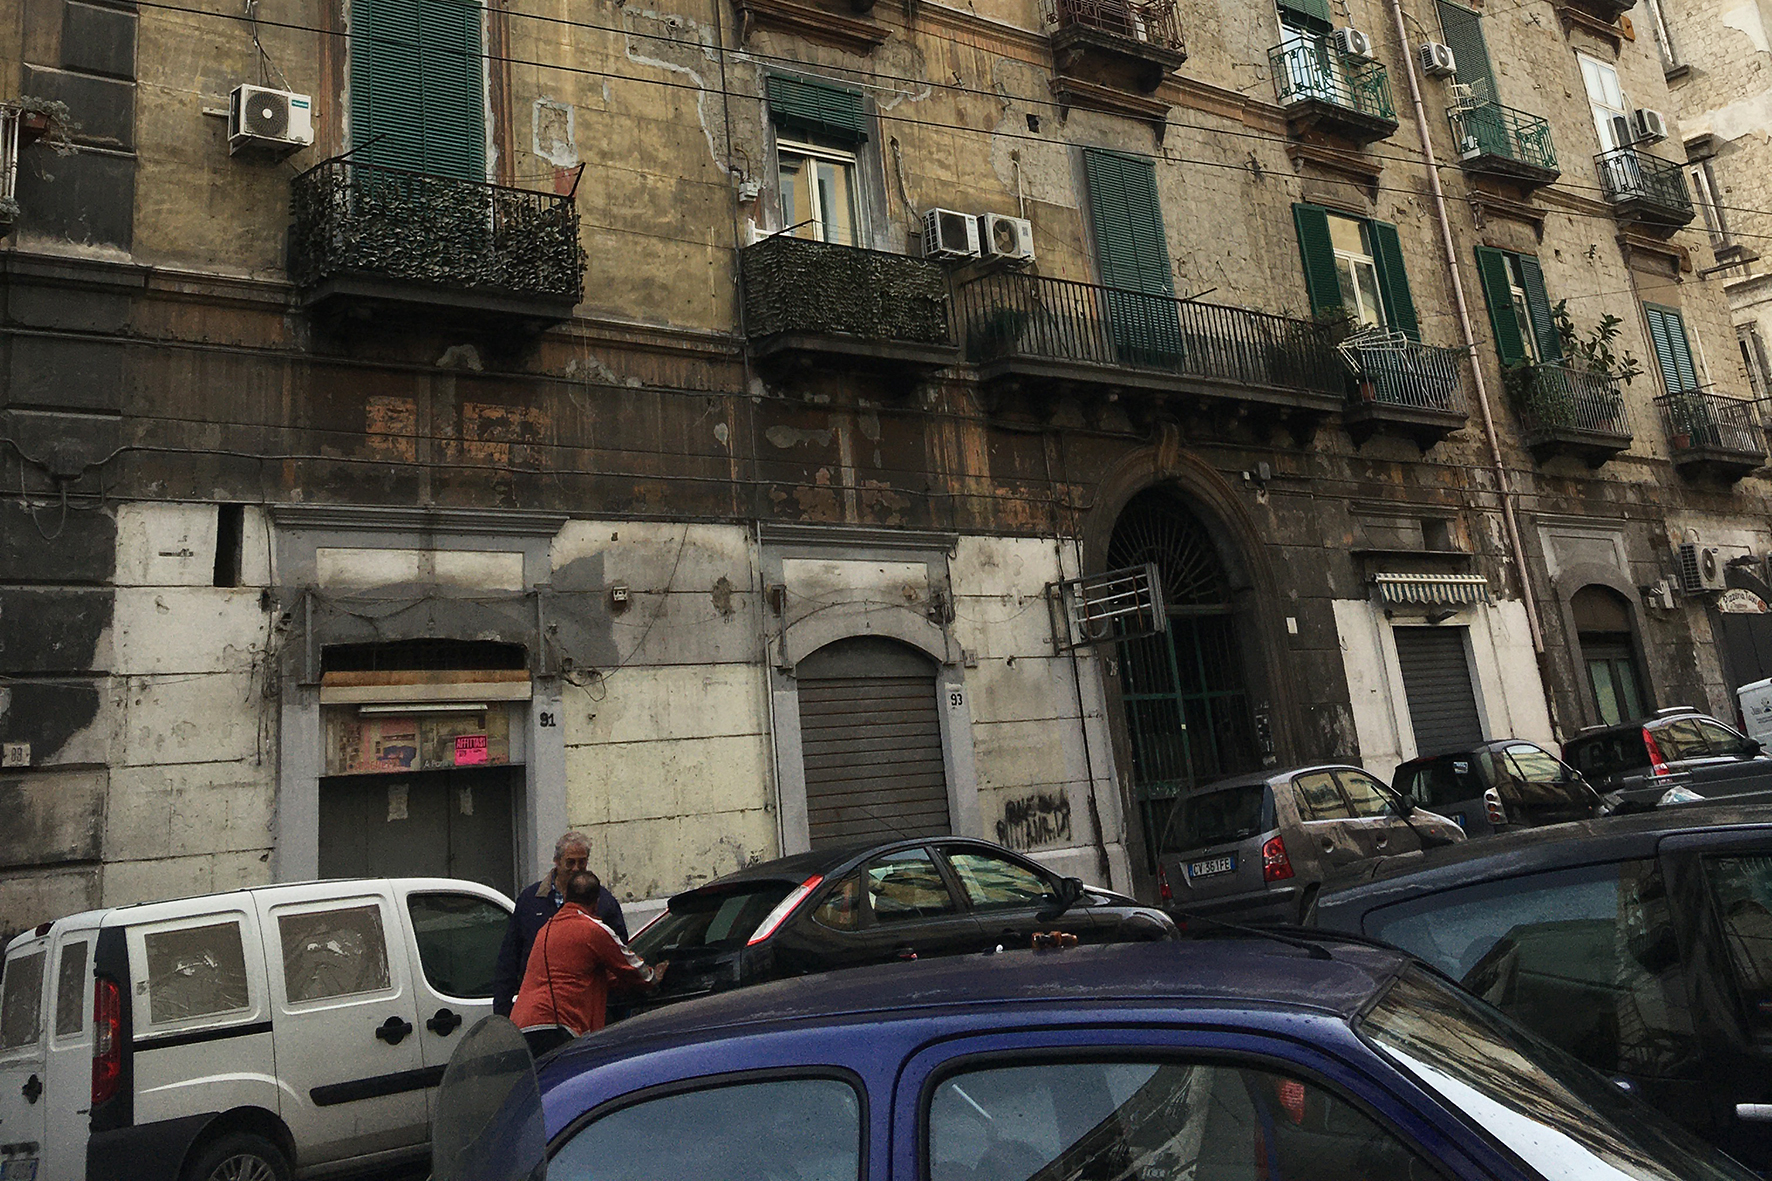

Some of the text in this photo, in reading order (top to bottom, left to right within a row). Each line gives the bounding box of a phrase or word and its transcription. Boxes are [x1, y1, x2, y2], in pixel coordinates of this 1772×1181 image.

[950, 693, 963, 706] 93
[540, 711, 557, 727] 91
[456, 736, 487, 749] AFFITTASI
